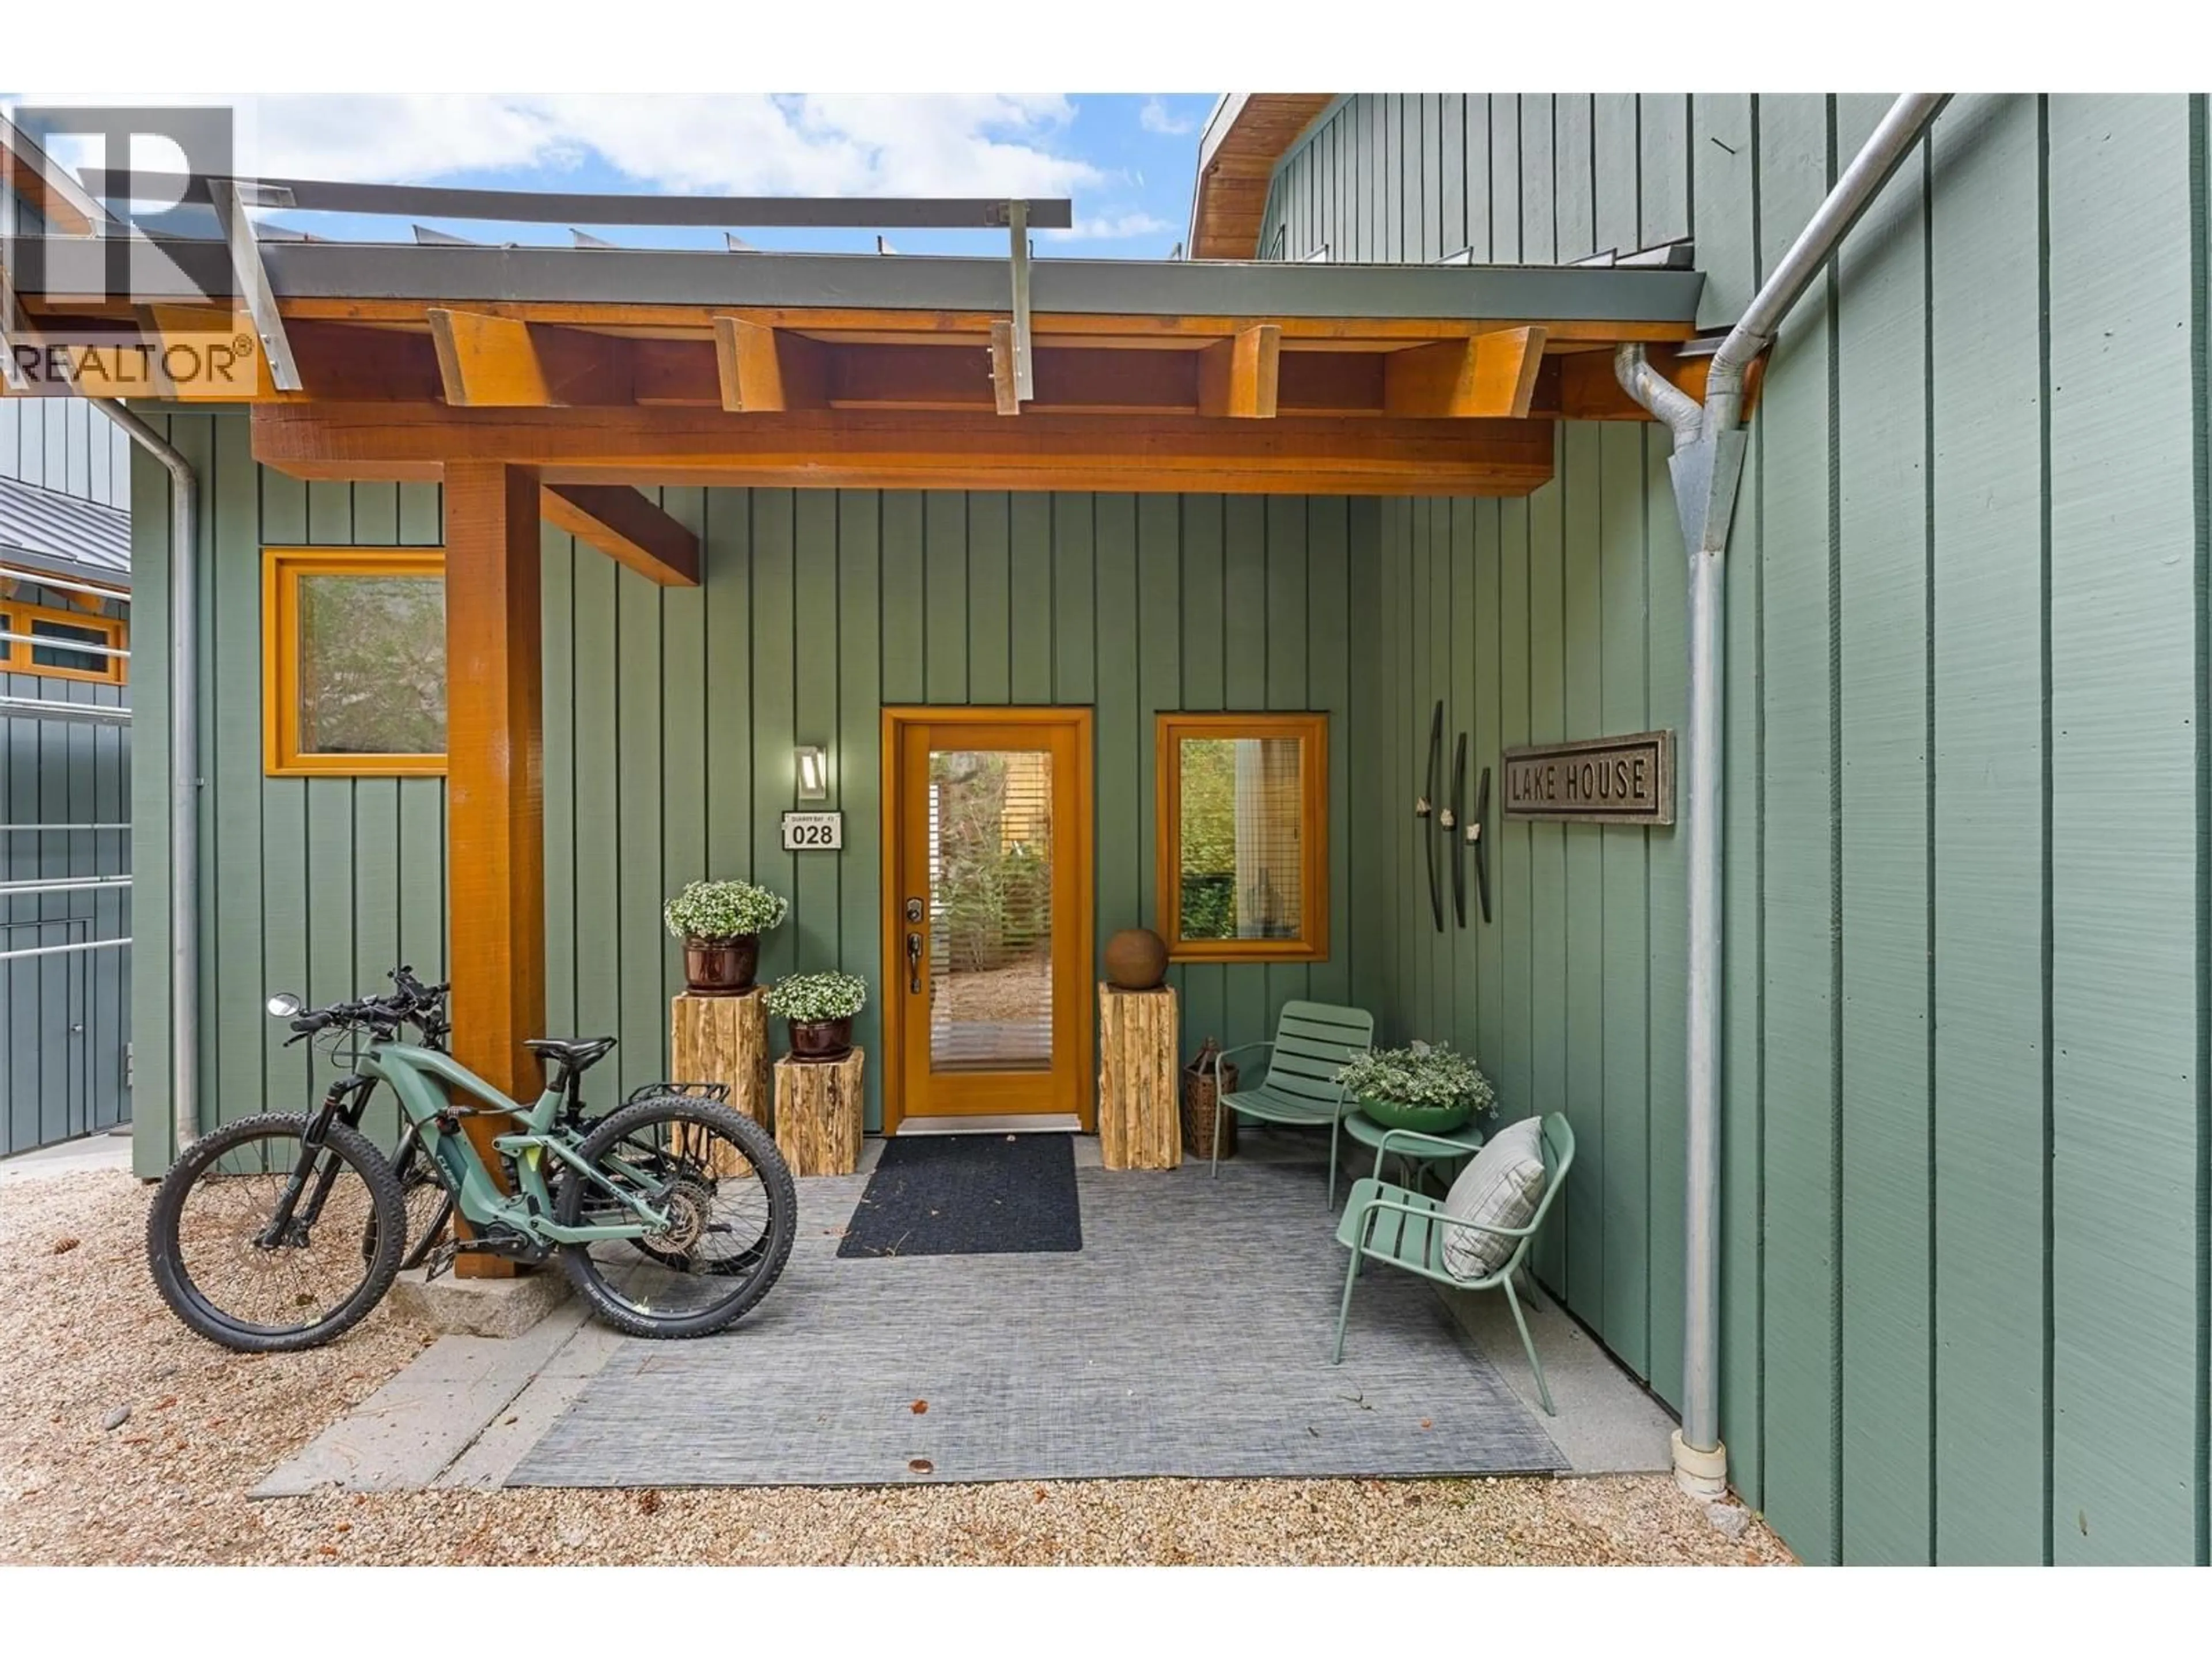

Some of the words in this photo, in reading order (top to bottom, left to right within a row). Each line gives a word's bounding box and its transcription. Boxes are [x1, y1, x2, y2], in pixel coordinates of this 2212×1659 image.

[1512, 766, 1555, 801] LAKE
[1566, 759, 1647, 800] HOUSE
[793, 825, 833, 844] 028
